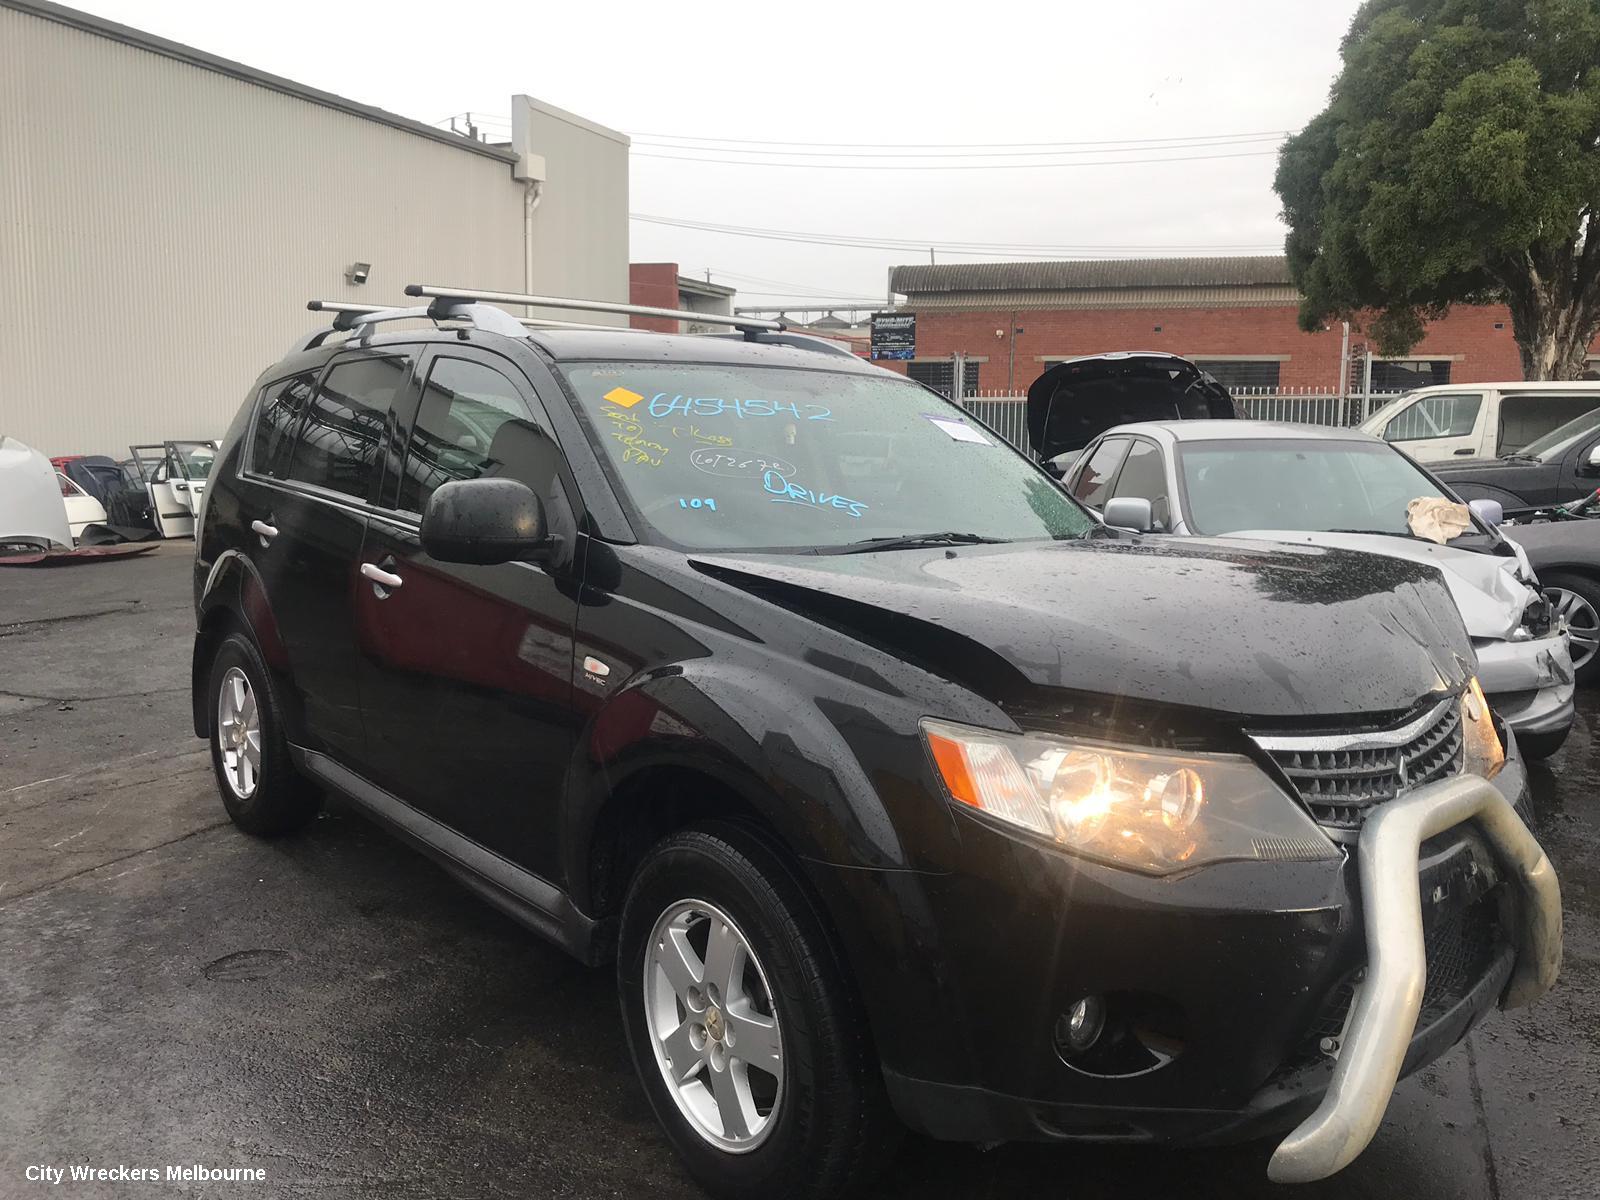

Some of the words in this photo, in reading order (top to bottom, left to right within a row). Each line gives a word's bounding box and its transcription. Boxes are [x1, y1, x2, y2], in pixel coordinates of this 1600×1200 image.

[648, 392, 836, 421] 6454542
[680, 498, 717, 511] 109
[764, 470, 869, 517] DRIVES
